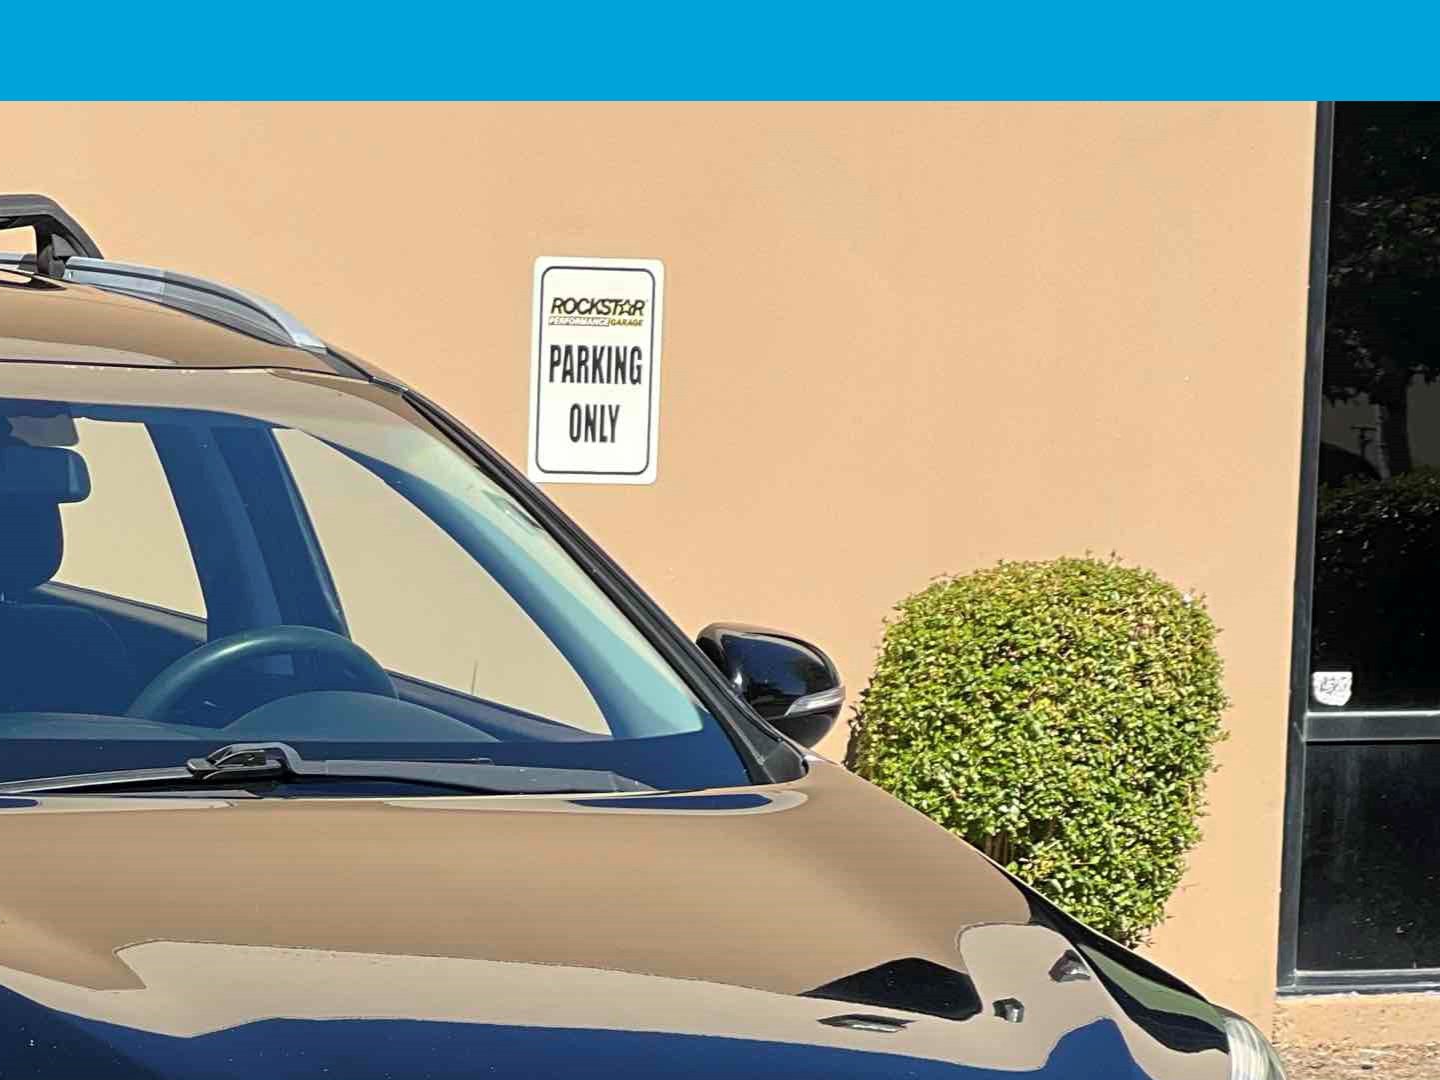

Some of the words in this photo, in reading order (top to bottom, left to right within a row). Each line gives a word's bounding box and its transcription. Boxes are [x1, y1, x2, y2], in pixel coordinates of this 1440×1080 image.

[550, 297, 646, 317] ROCKSTAR
[549, 344, 643, 385] PARKING
[569, 403, 621, 443] ONLY
